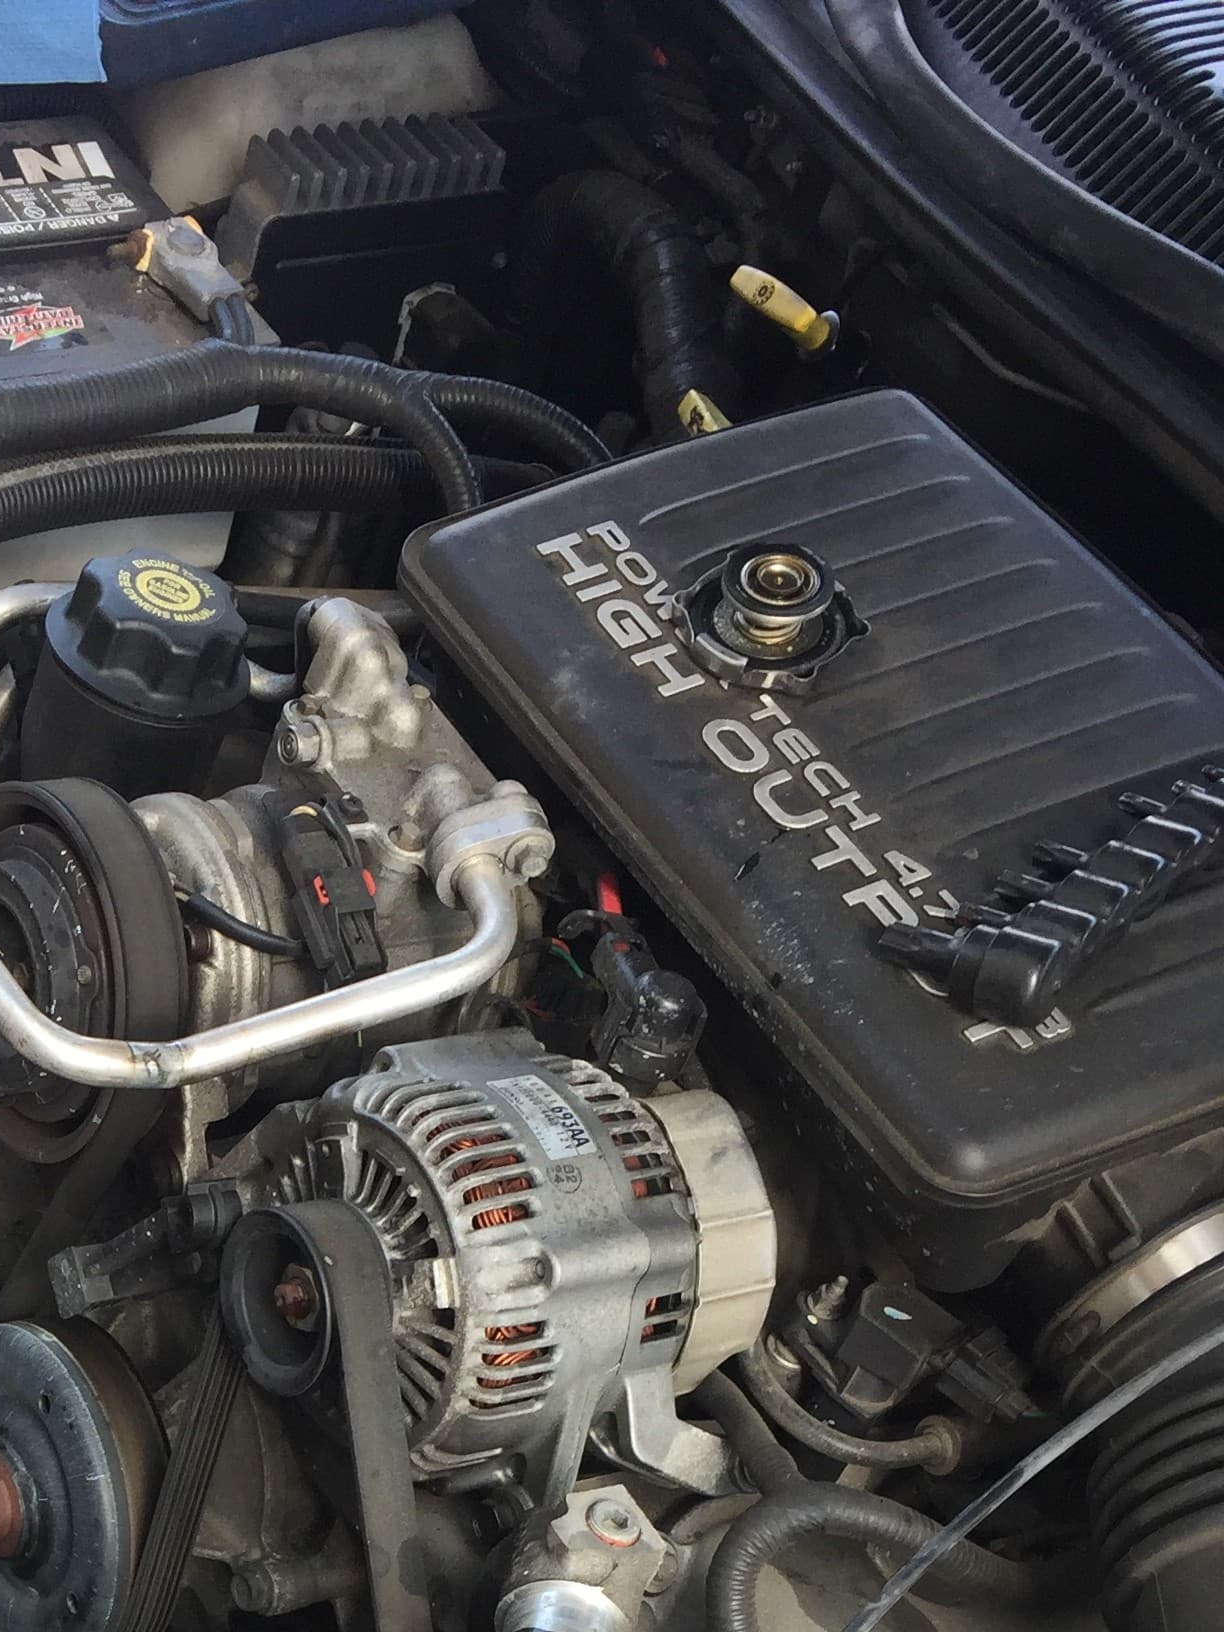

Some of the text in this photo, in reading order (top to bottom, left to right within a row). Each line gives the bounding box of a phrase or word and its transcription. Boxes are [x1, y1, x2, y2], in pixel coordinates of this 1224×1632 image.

[49, 215, 109, 230] DANGER
[132, 559, 180, 573] ENGINE
[118, 569, 132, 588] SEE
[173, 607, 217, 622] MANUAL
[750, 693, 881, 832] TECH
[535, 532, 1034, 1050] HIGH OUTPT
[550, 1105, 591, 1148] 693AA
